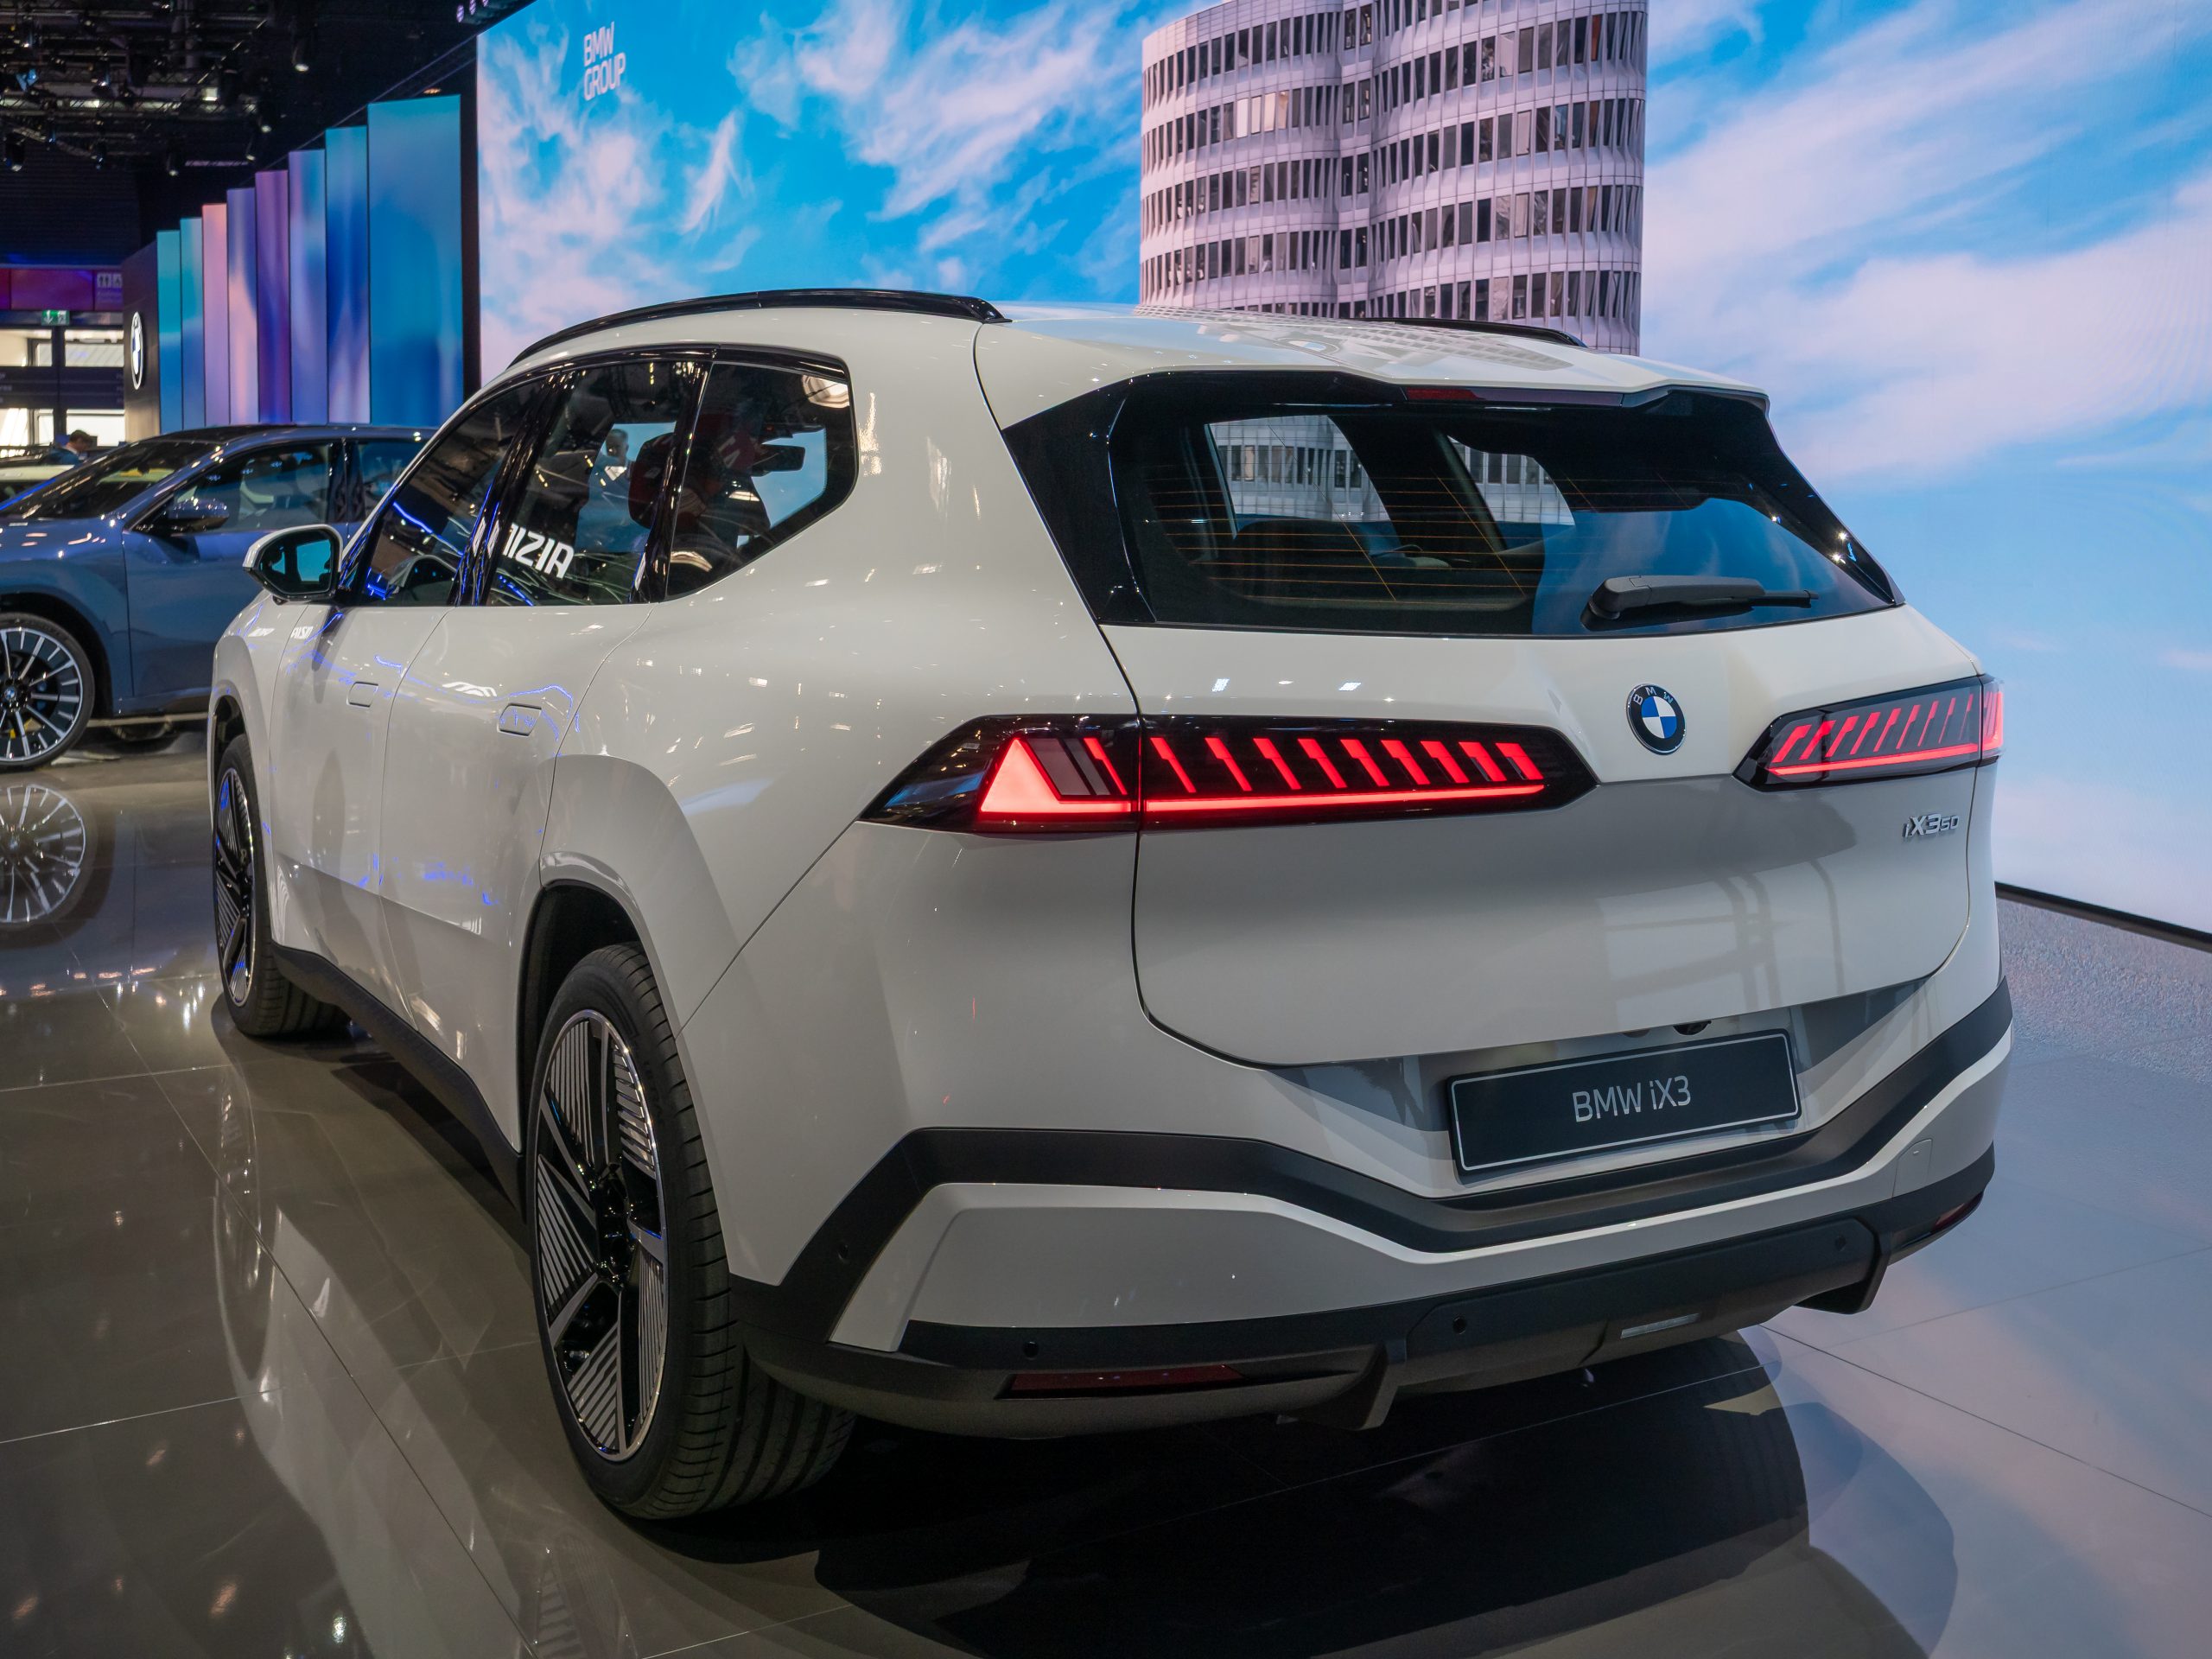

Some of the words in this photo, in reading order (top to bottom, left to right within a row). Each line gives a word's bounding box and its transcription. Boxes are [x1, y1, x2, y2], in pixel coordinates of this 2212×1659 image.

[583, 21, 615, 67] BMW
[583, 52, 626, 101] GROUP
[1632, 686, 1674, 706] BMW
[1572, 1082, 1642, 1122] BMW
[1649, 1075, 1692, 1110] iX3
